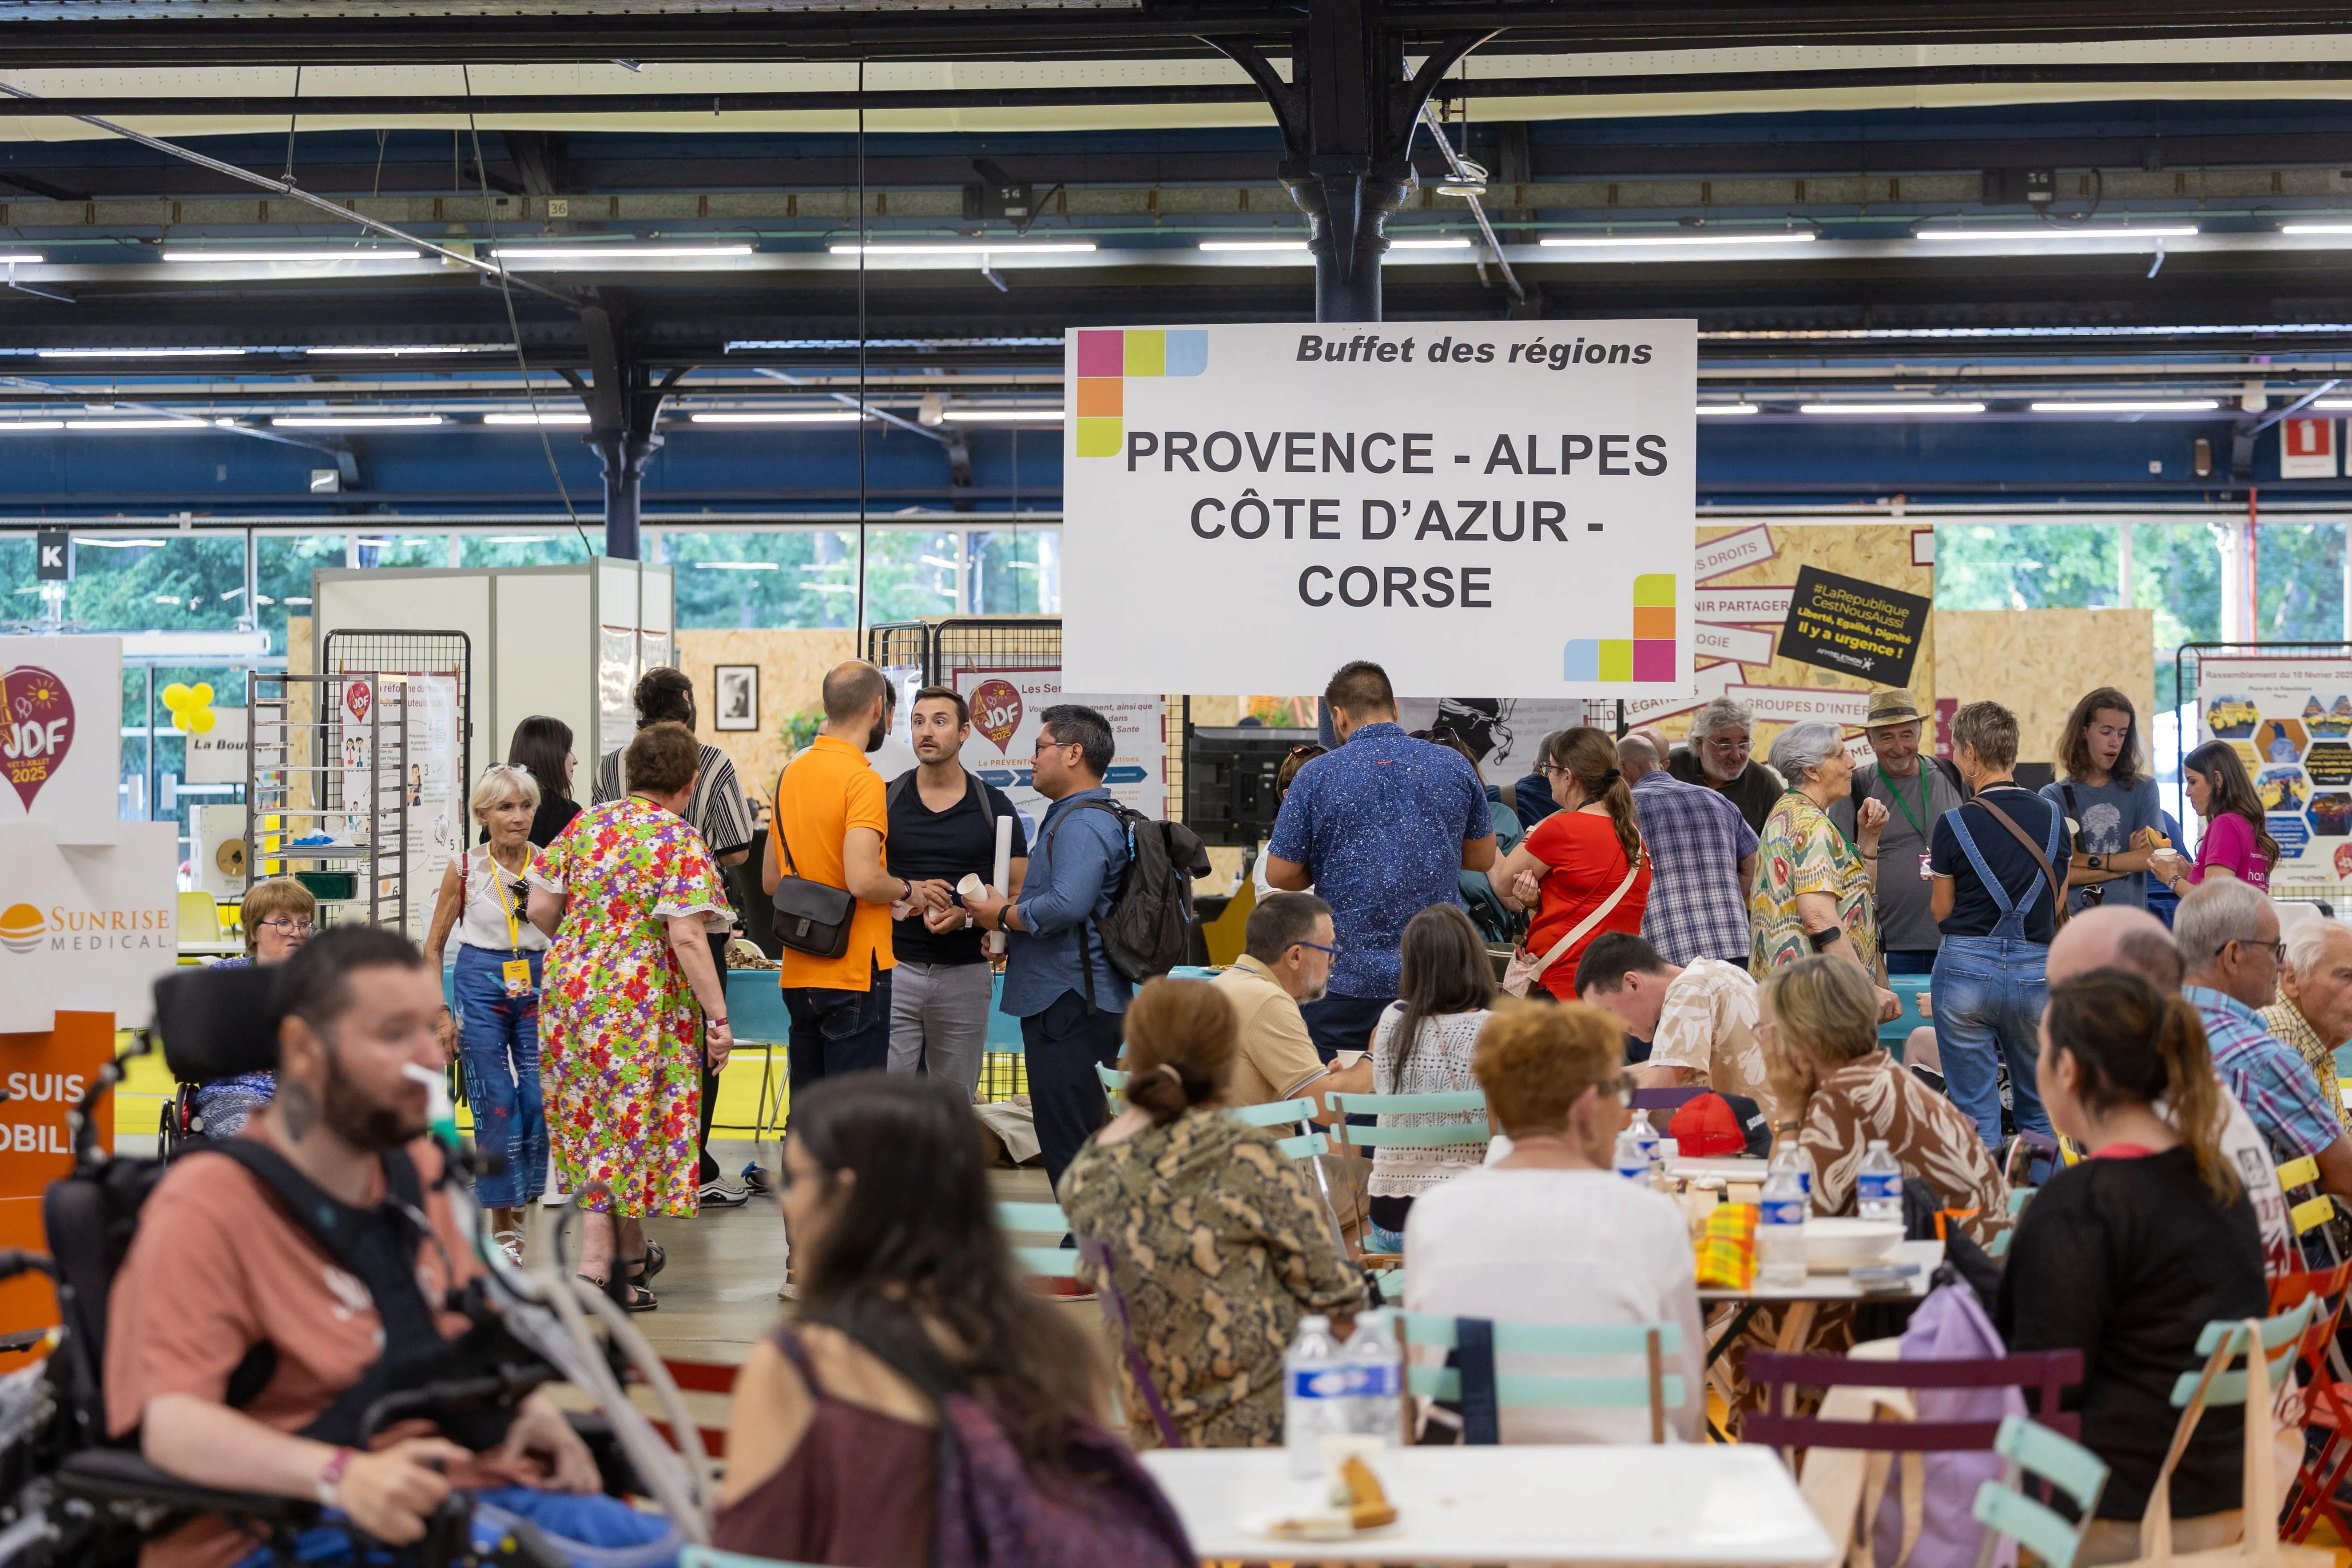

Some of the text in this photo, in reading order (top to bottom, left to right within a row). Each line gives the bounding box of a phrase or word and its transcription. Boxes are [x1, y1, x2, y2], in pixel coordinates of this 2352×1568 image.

[551, 203, 566, 214] 36
[1296, 335, 1653, 371] Buffet des régions
[1128, 431, 1434, 474] PROVENCE
[1483, 434, 1667, 476] ALPES
[1191, 488, 1340, 540] CÔTE
[42, 545, 63, 567] K
[1708, 542, 1757, 566] DROITS
[1299, 565, 1492, 608] CORSE
[1719, 600, 1790, 611] PARTAGER
[1813, 583, 1910, 618] #LaRepublique
[1812, 595, 1905, 629] CestNousAussi
[1797, 607, 1912, 645] Liberté, Egalité, Dignité
[1695, 633, 1730, 648] OGIE
[1809, 626, 1821, 639] y
[1822, 630, 1832, 640] a
[1834, 632, 1895, 657] urgence
[1896, 647, 1904, 659] !
[417, 684, 425, 693] du
[1022, 684, 1041, 693] Les
[353, 694, 369, 710] JDF
[1745, 698, 1811, 712] GROUPES
[985, 702, 1018, 729] JDF
[3, 717, 68, 759] JDF
[194, 739, 211, 750] La
[991, 729, 1012, 741] 2025
[11, 766, 47, 784] 2025
[424, 764, 429, 776] 3
[450, 838, 455, 850] 5
[51, 935, 166, 951] MEDICAL
[8, 1072, 85, 1103] SUIS
